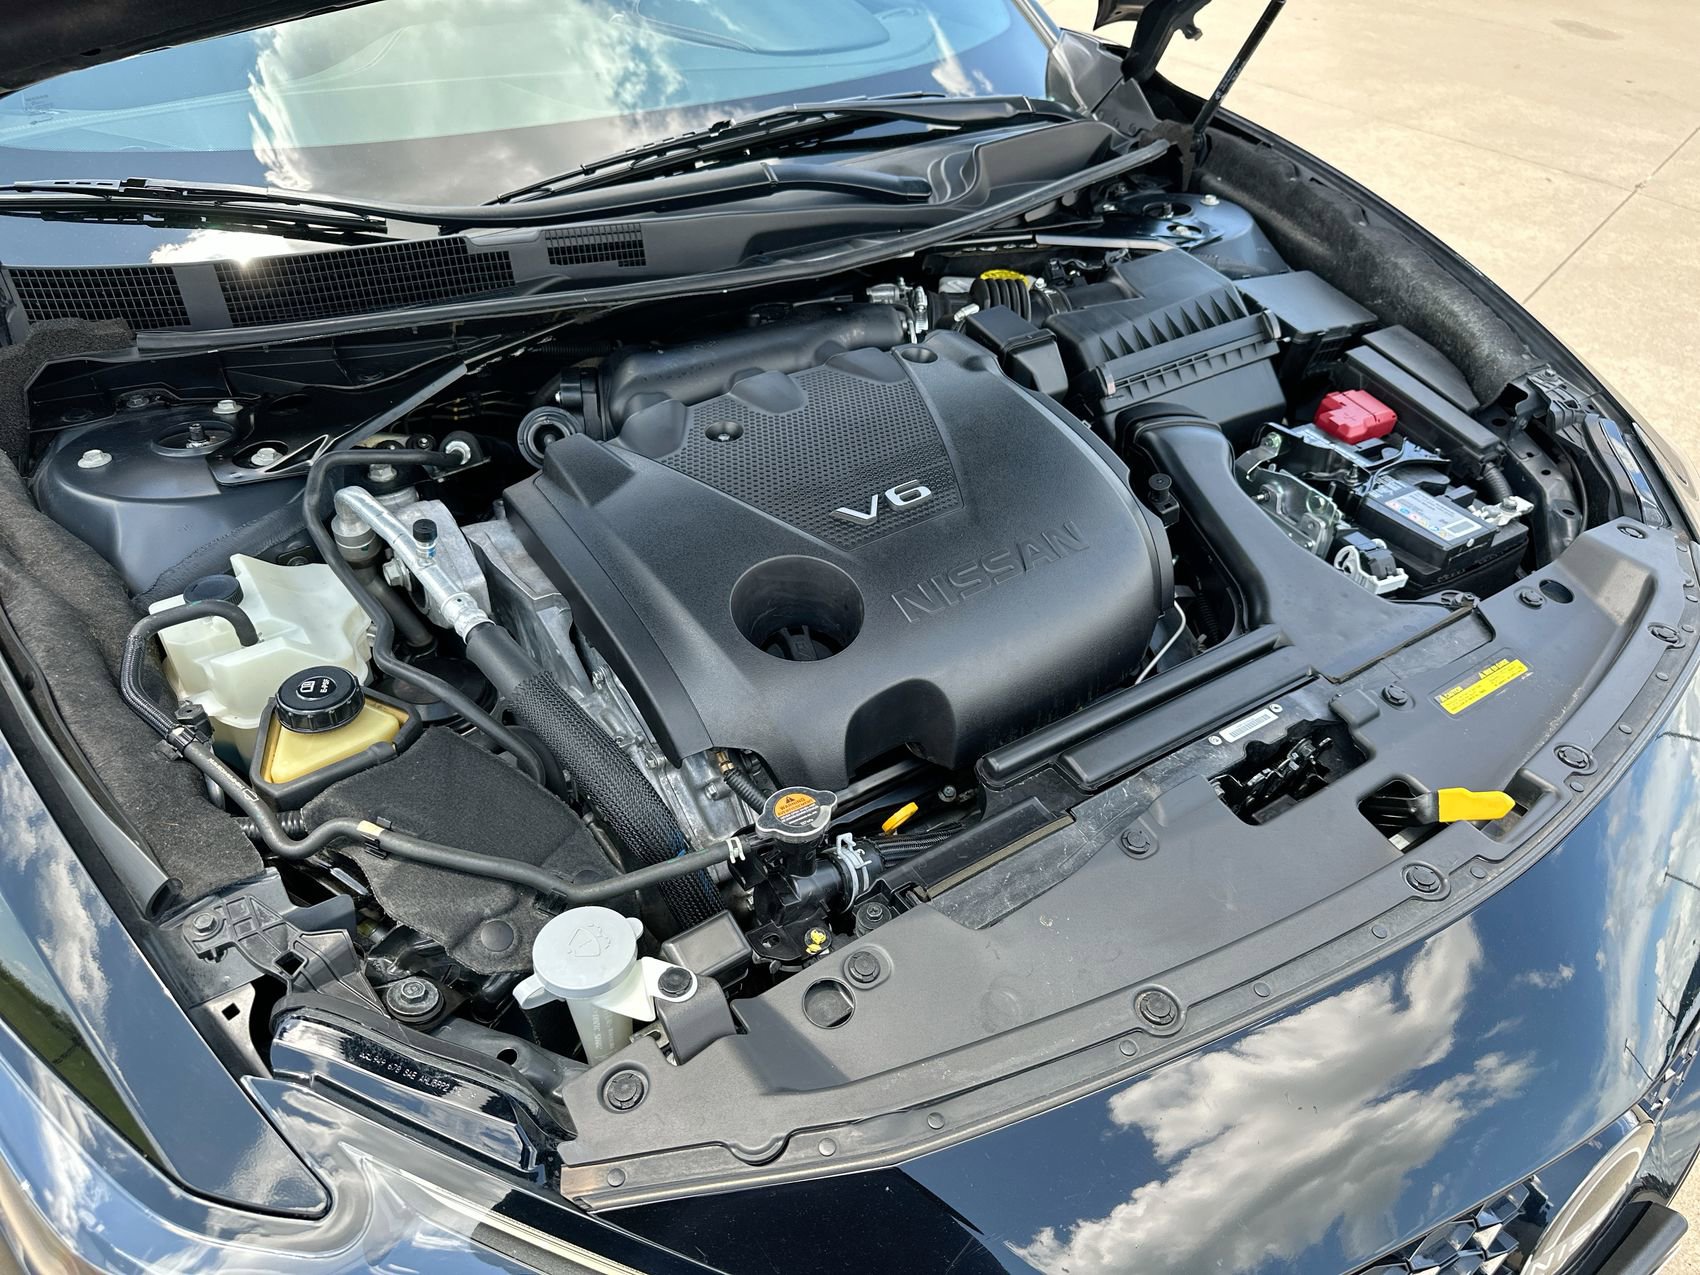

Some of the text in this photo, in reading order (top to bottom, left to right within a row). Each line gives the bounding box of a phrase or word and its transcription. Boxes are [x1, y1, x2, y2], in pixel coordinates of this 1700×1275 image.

[831, 479, 932, 525] V6
[890, 520, 1090, 624] NISSAN
[779, 797, 806, 811] WARNING
[402, 1068, 418, 1081] SAE
